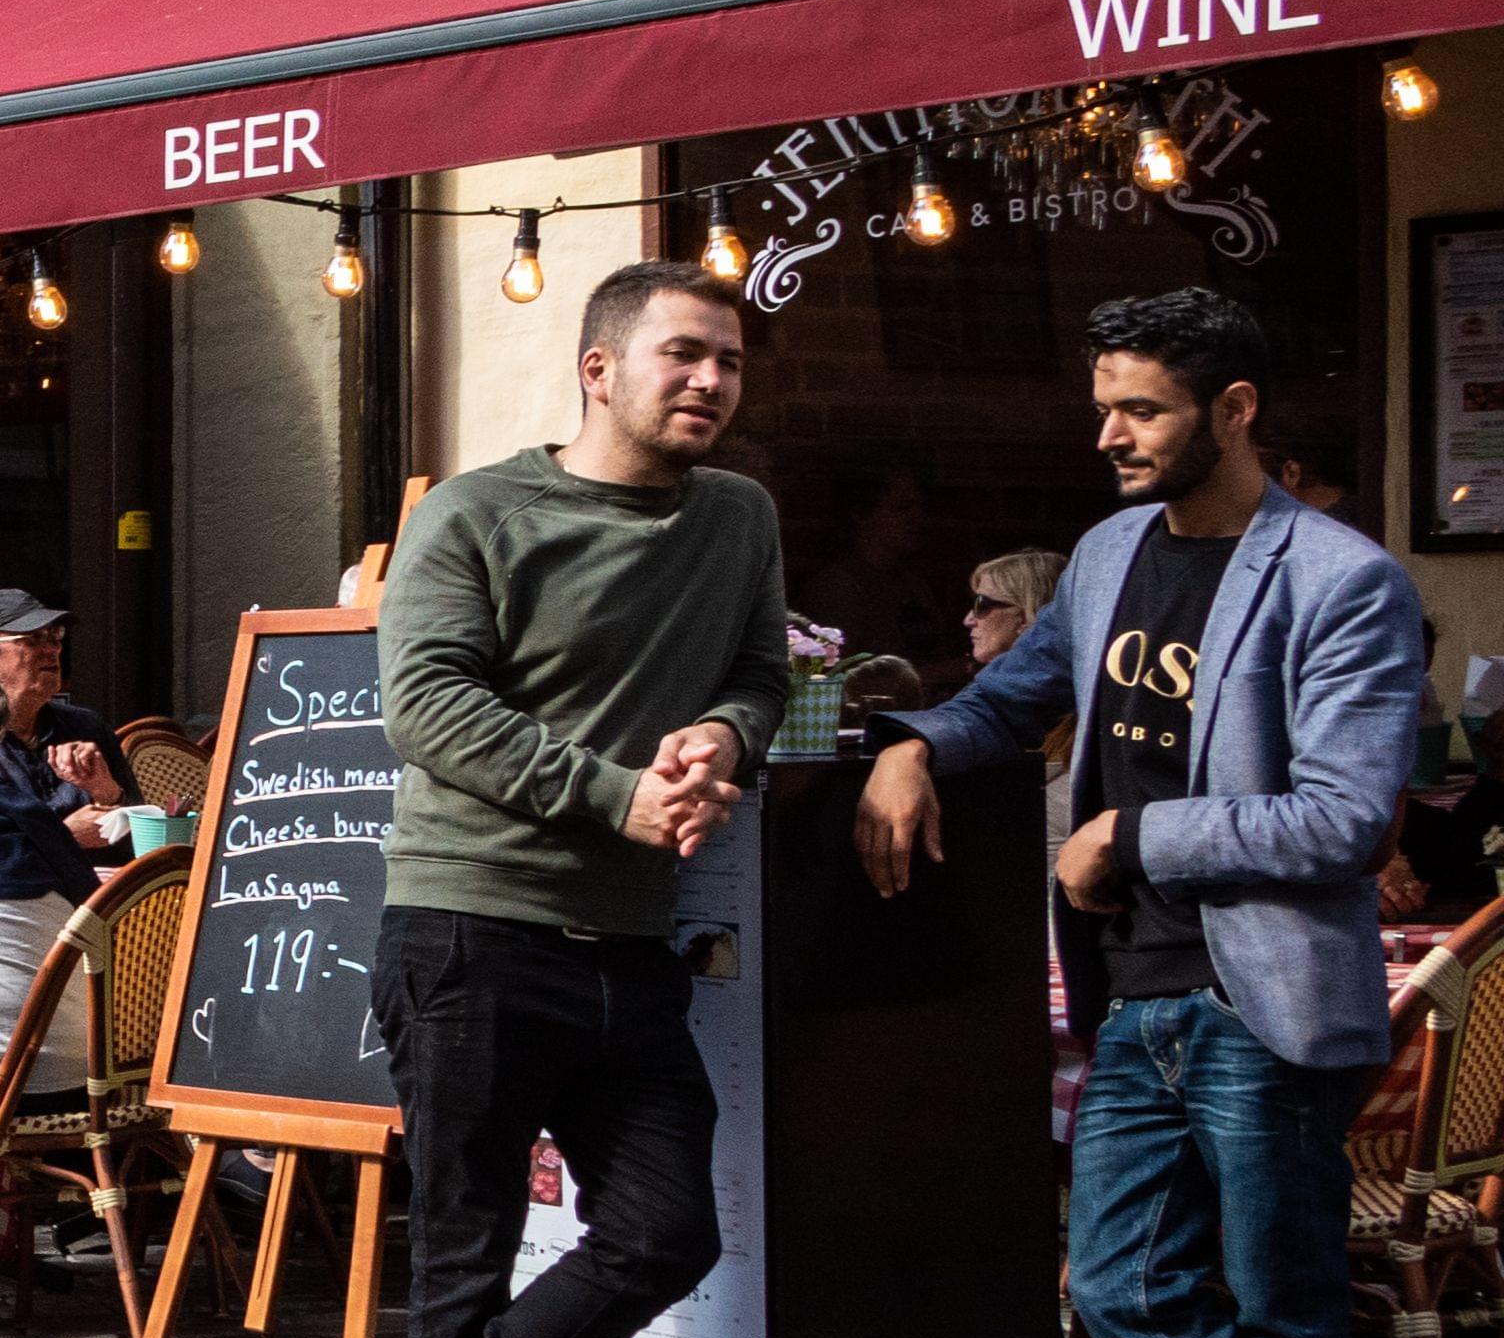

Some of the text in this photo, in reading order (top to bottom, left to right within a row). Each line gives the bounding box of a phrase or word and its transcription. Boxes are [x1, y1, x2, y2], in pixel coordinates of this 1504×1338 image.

[164, 108, 326, 190] BEER
[1008, 184, 1139, 224] BISTRO
[234, 759, 335, 800] Swedish
[224, 813, 318, 854] Cheese
[218, 865, 342, 910] Lasagna
[240, 928, 369, 995] 119:-
